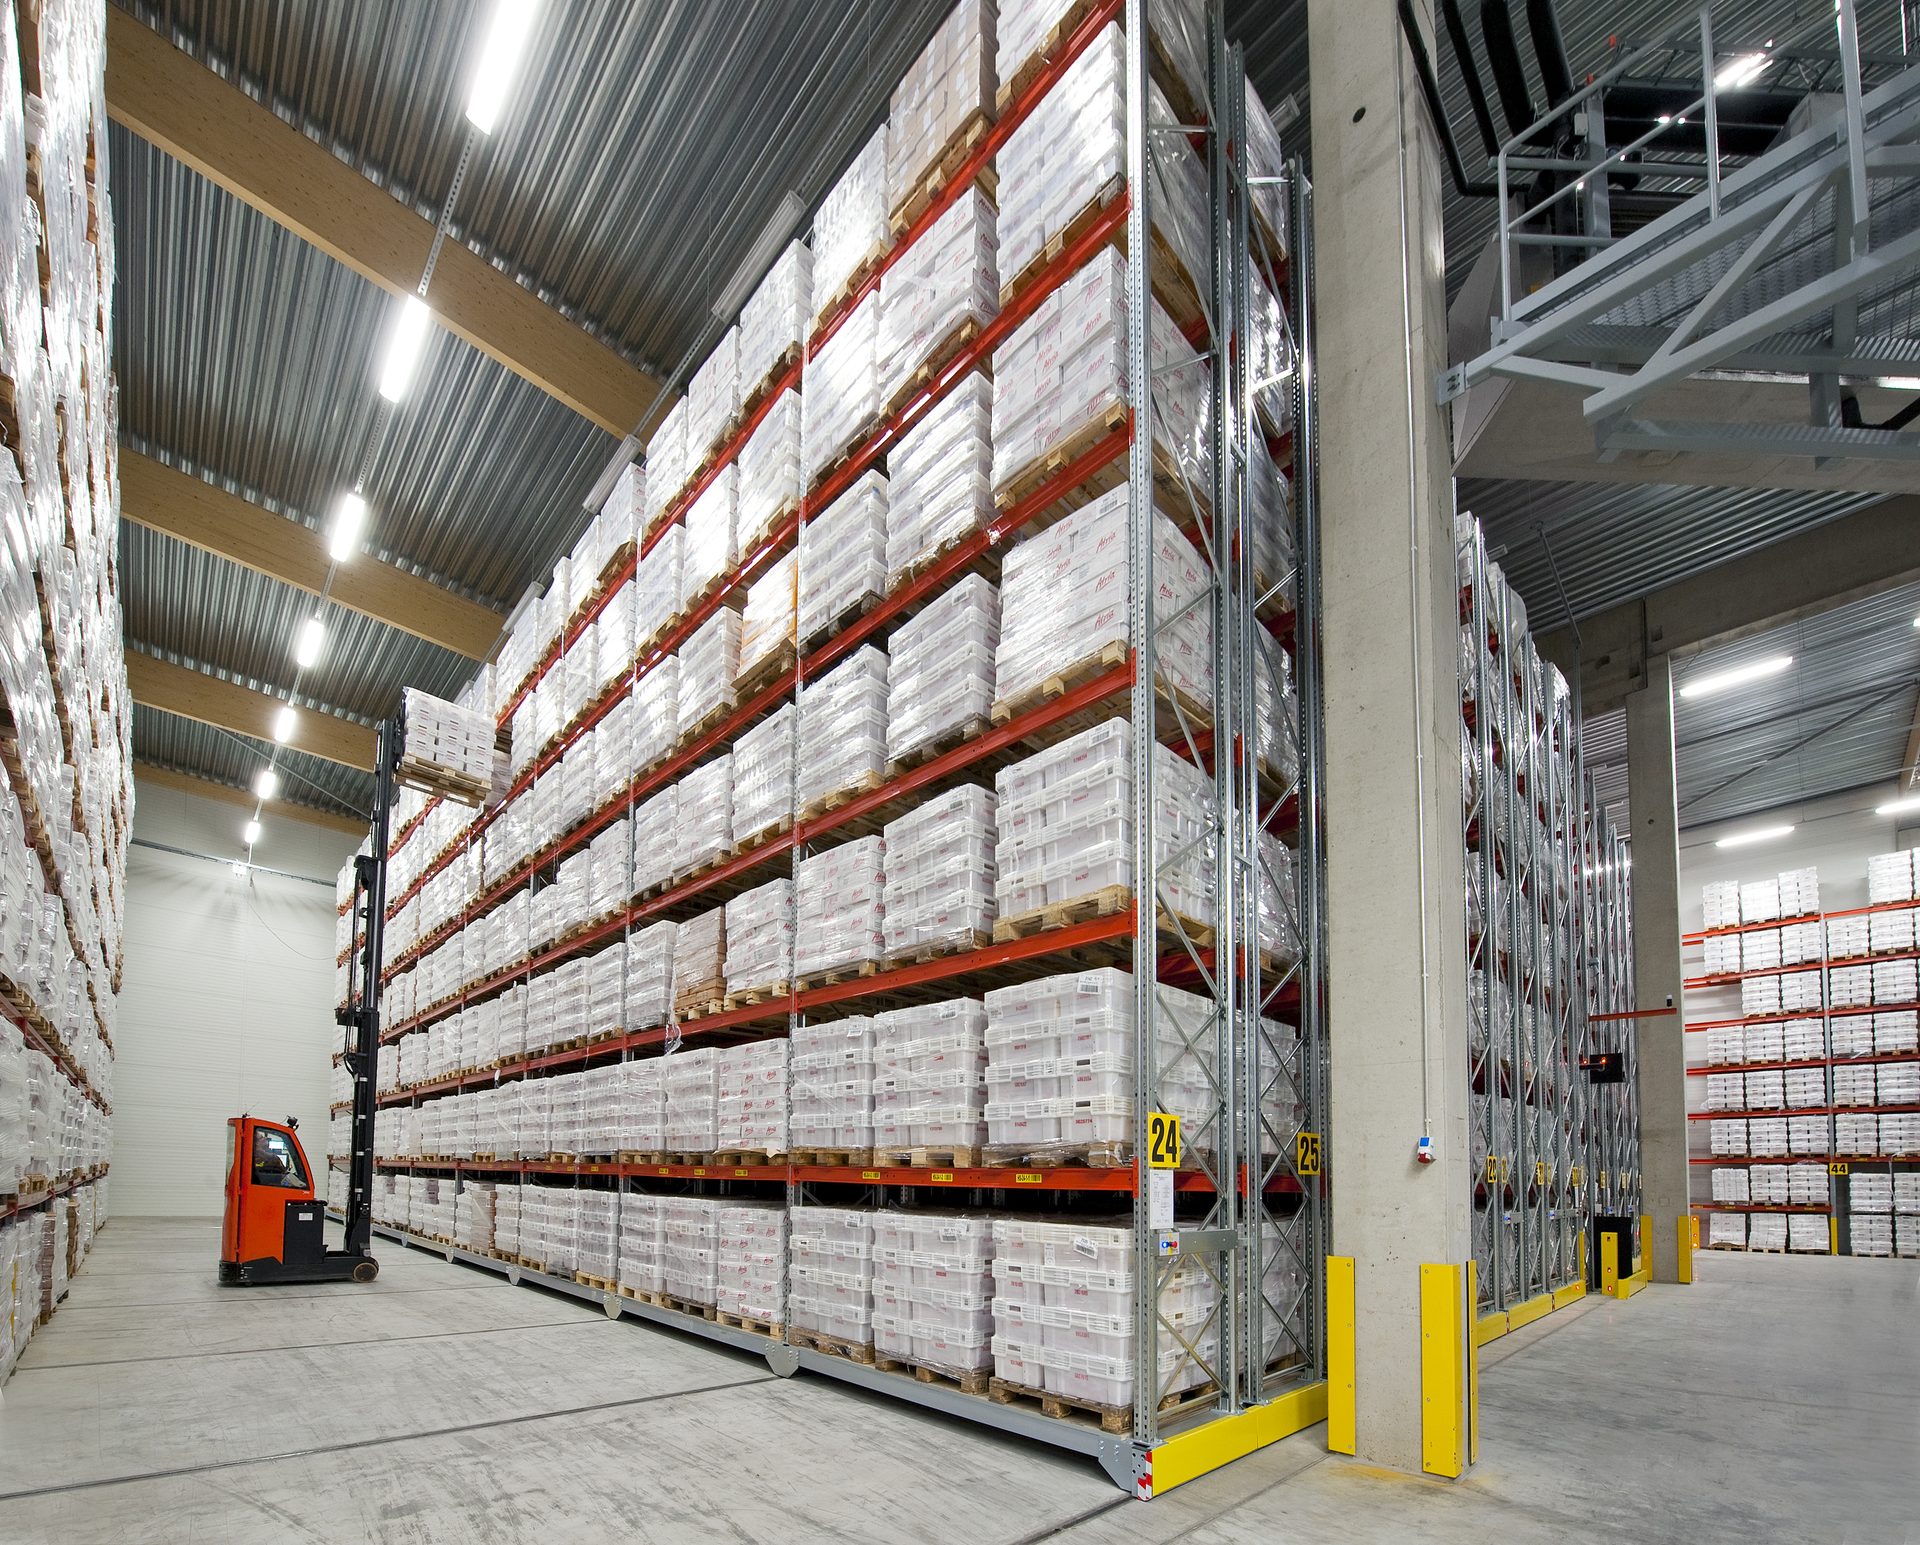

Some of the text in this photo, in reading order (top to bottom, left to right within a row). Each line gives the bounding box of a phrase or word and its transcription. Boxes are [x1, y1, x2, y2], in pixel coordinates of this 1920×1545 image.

[1096, 531, 1117, 553] Atria
[1162, 546, 1175, 560] Atria
[1095, 571, 1116, 593] Atria
[1185, 568, 1197, 582] Atria
[1159, 583, 1174, 597] Atria
[1095, 610, 1115, 630] Atria
[1152, 1117, 1177, 1162] 24
[1300, 1136, 1319, 1172] 25
[1831, 1165, 1846, 1173] 44
